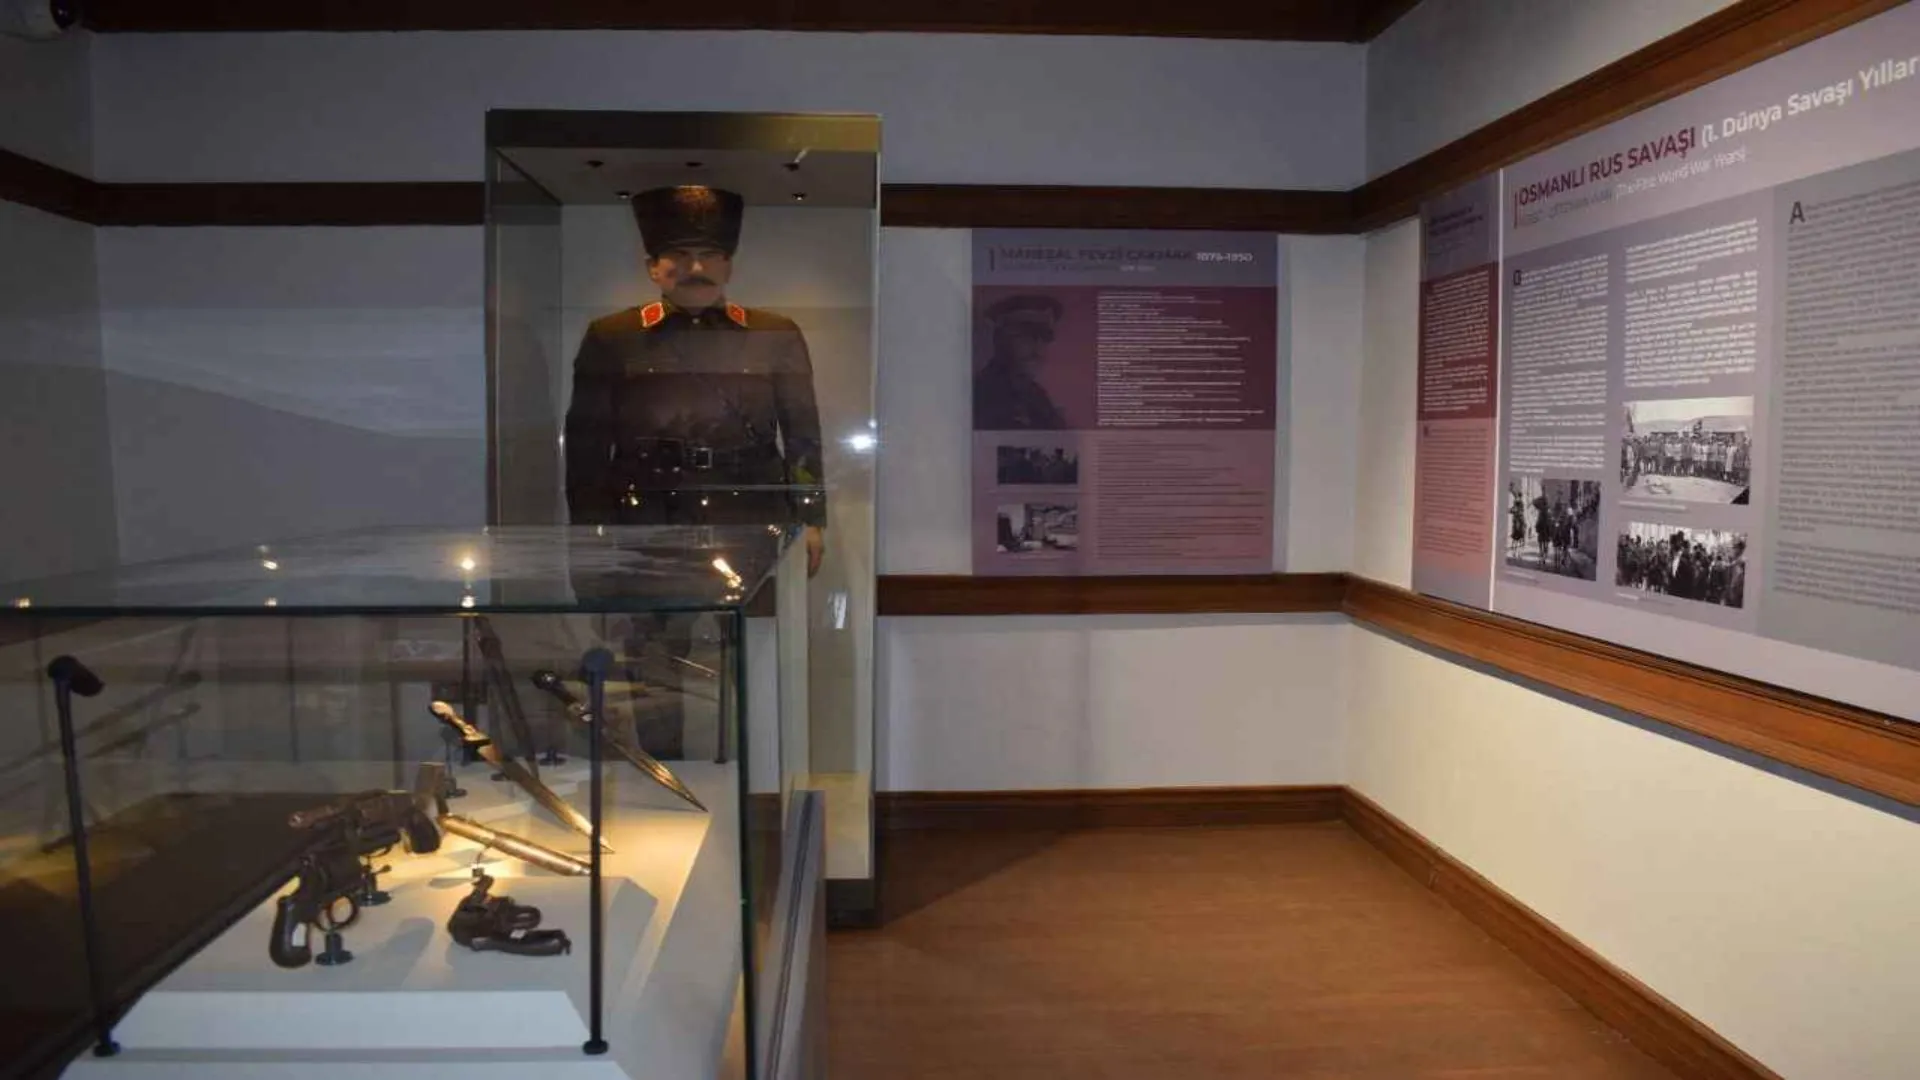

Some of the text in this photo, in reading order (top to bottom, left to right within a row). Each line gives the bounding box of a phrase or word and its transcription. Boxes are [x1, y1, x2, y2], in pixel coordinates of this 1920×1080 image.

[1518, 166, 1584, 206] OSMANLI
[1589, 153, 1623, 183] RUS
[1627, 127, 1696, 169] SAVAŞI
[1722, 105, 1783, 138] Dünya
[1787, 78, 1854, 116] Savaşı
